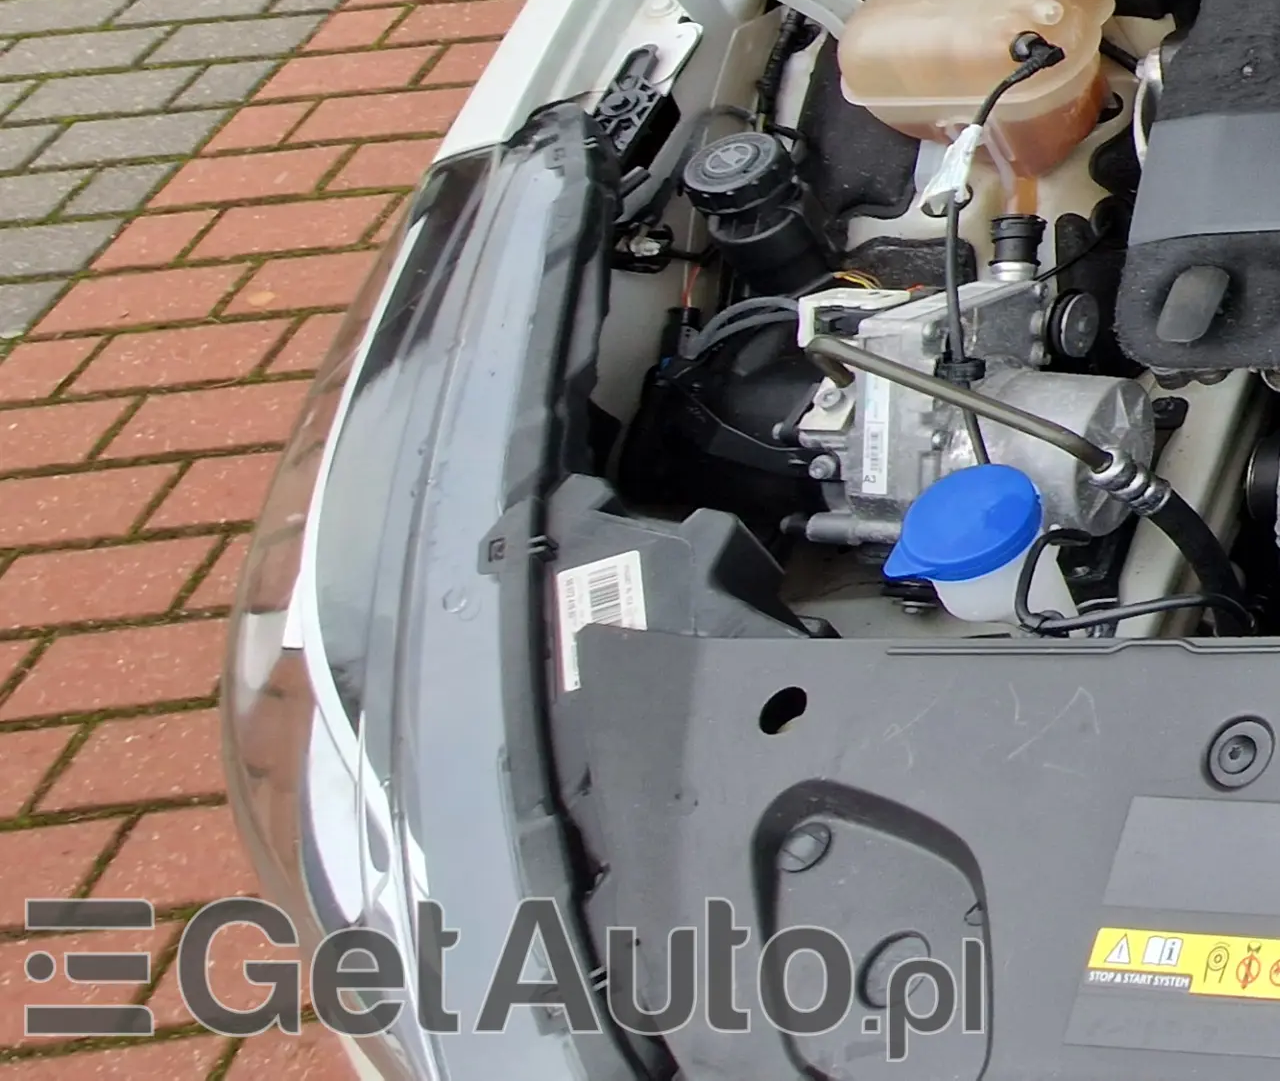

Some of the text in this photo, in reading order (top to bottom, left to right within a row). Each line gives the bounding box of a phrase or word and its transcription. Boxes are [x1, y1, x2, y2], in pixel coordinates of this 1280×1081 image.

[1088, 970, 1114, 982] STOP
[1122, 973, 1153, 985] START
[1153, 976, 1190, 988] SYSTEM
